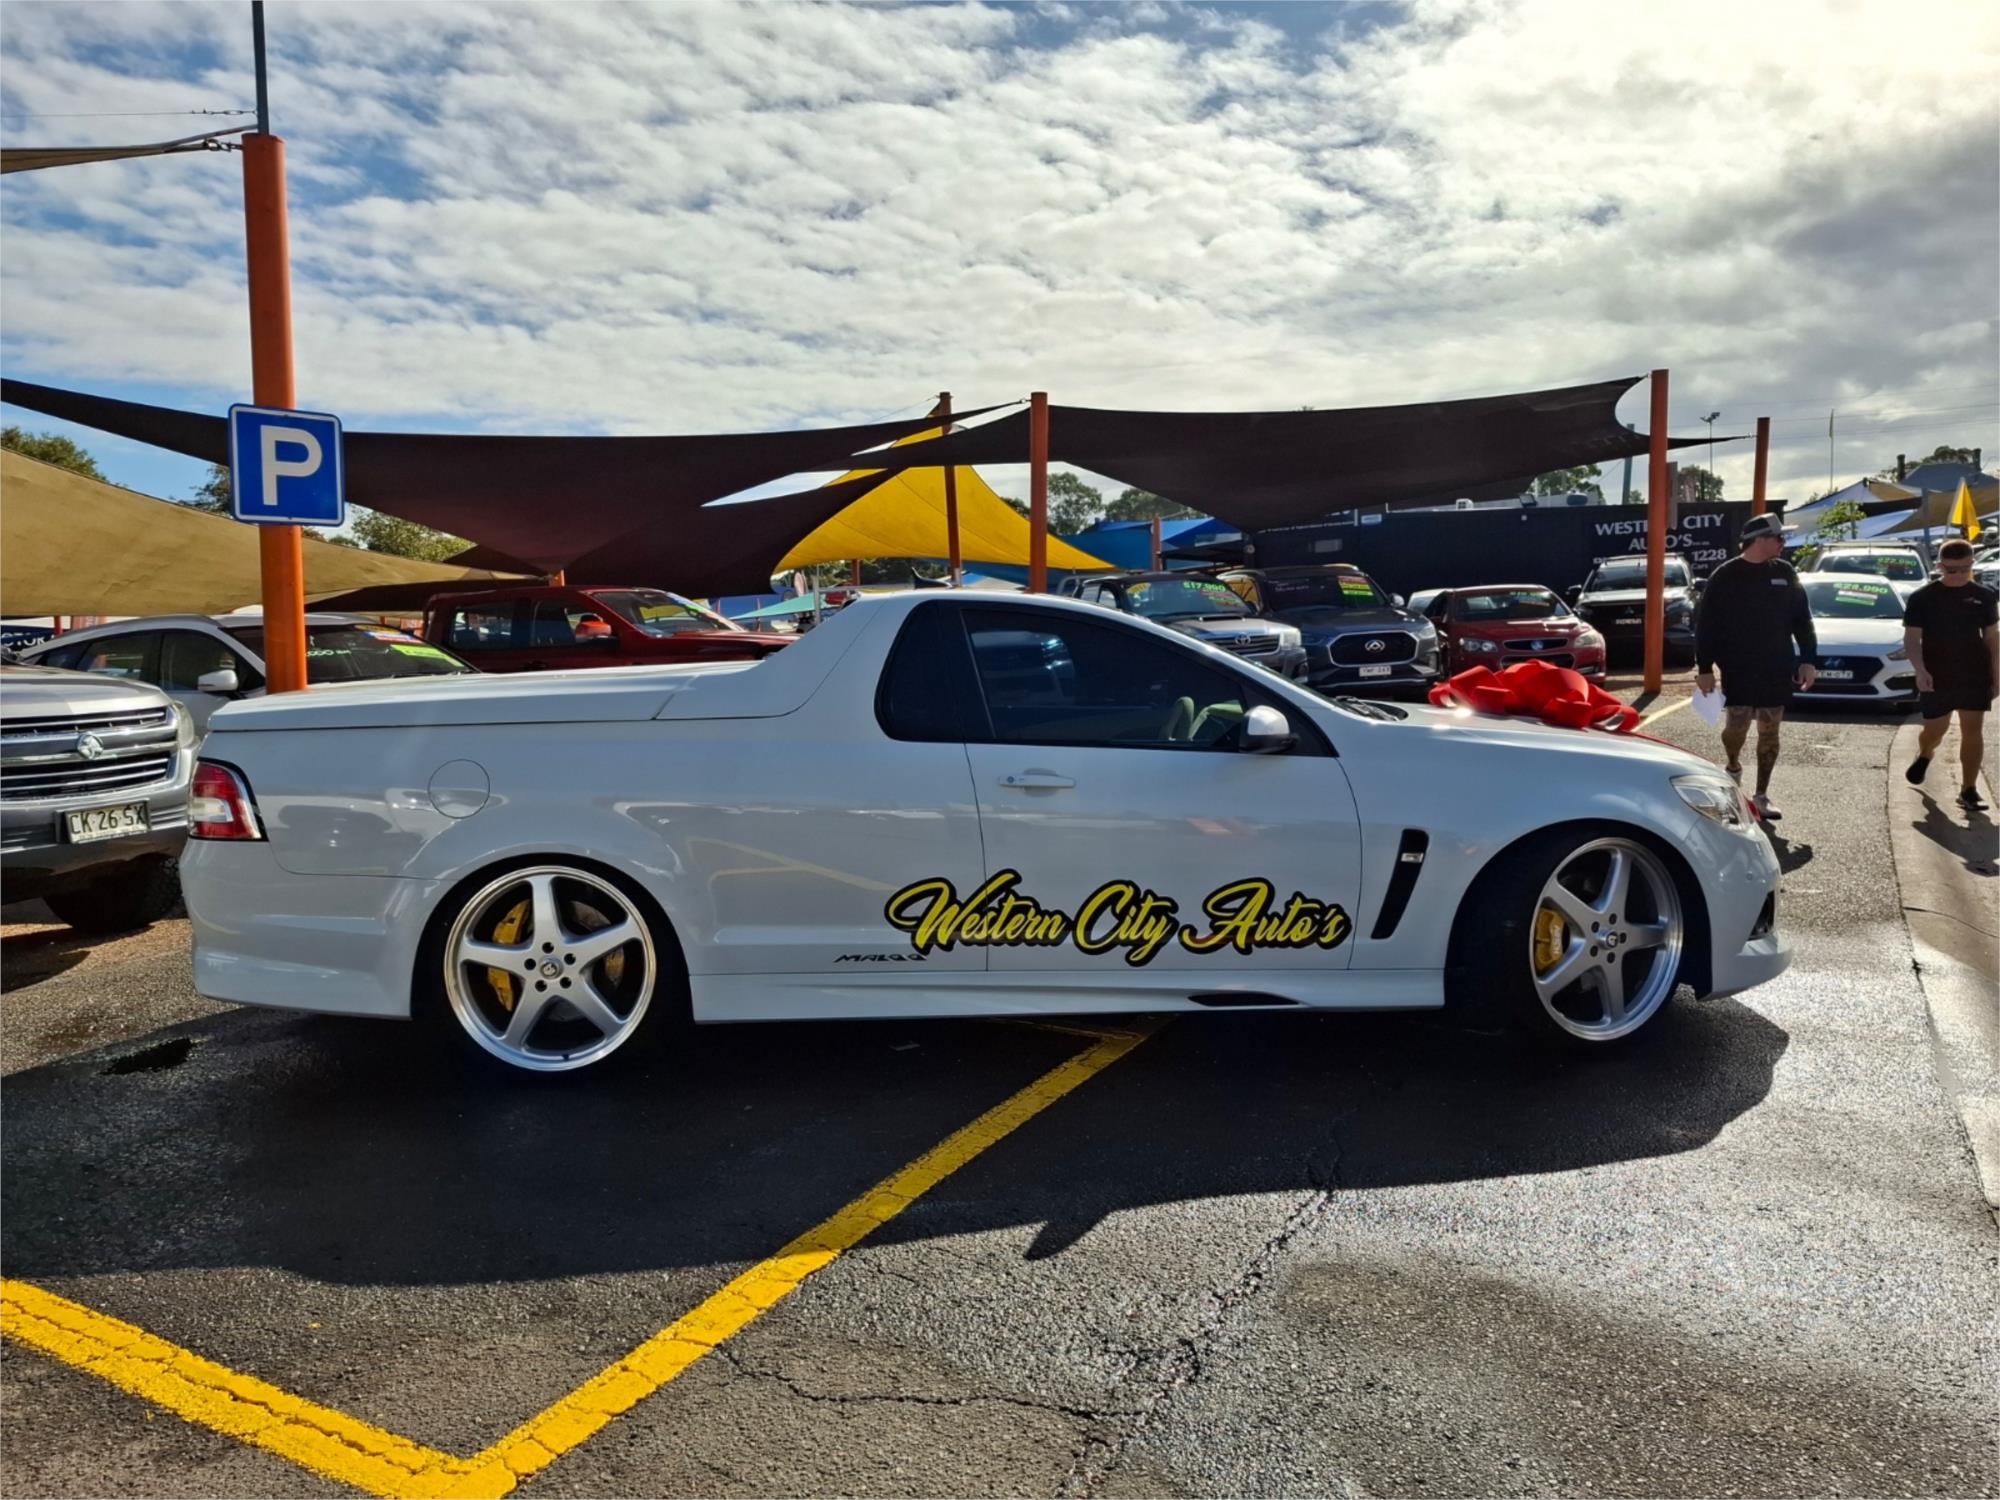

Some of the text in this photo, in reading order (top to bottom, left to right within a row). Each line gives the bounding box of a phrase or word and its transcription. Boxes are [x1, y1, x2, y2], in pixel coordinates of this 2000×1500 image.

[260, 424, 323, 506] P
[1683, 513, 1725, 529] CITY
[1628, 533, 1693, 551] AUO'S
[883, 868, 1352, 968] Western City Auto's
[833, 953, 928, 963] MALOO
